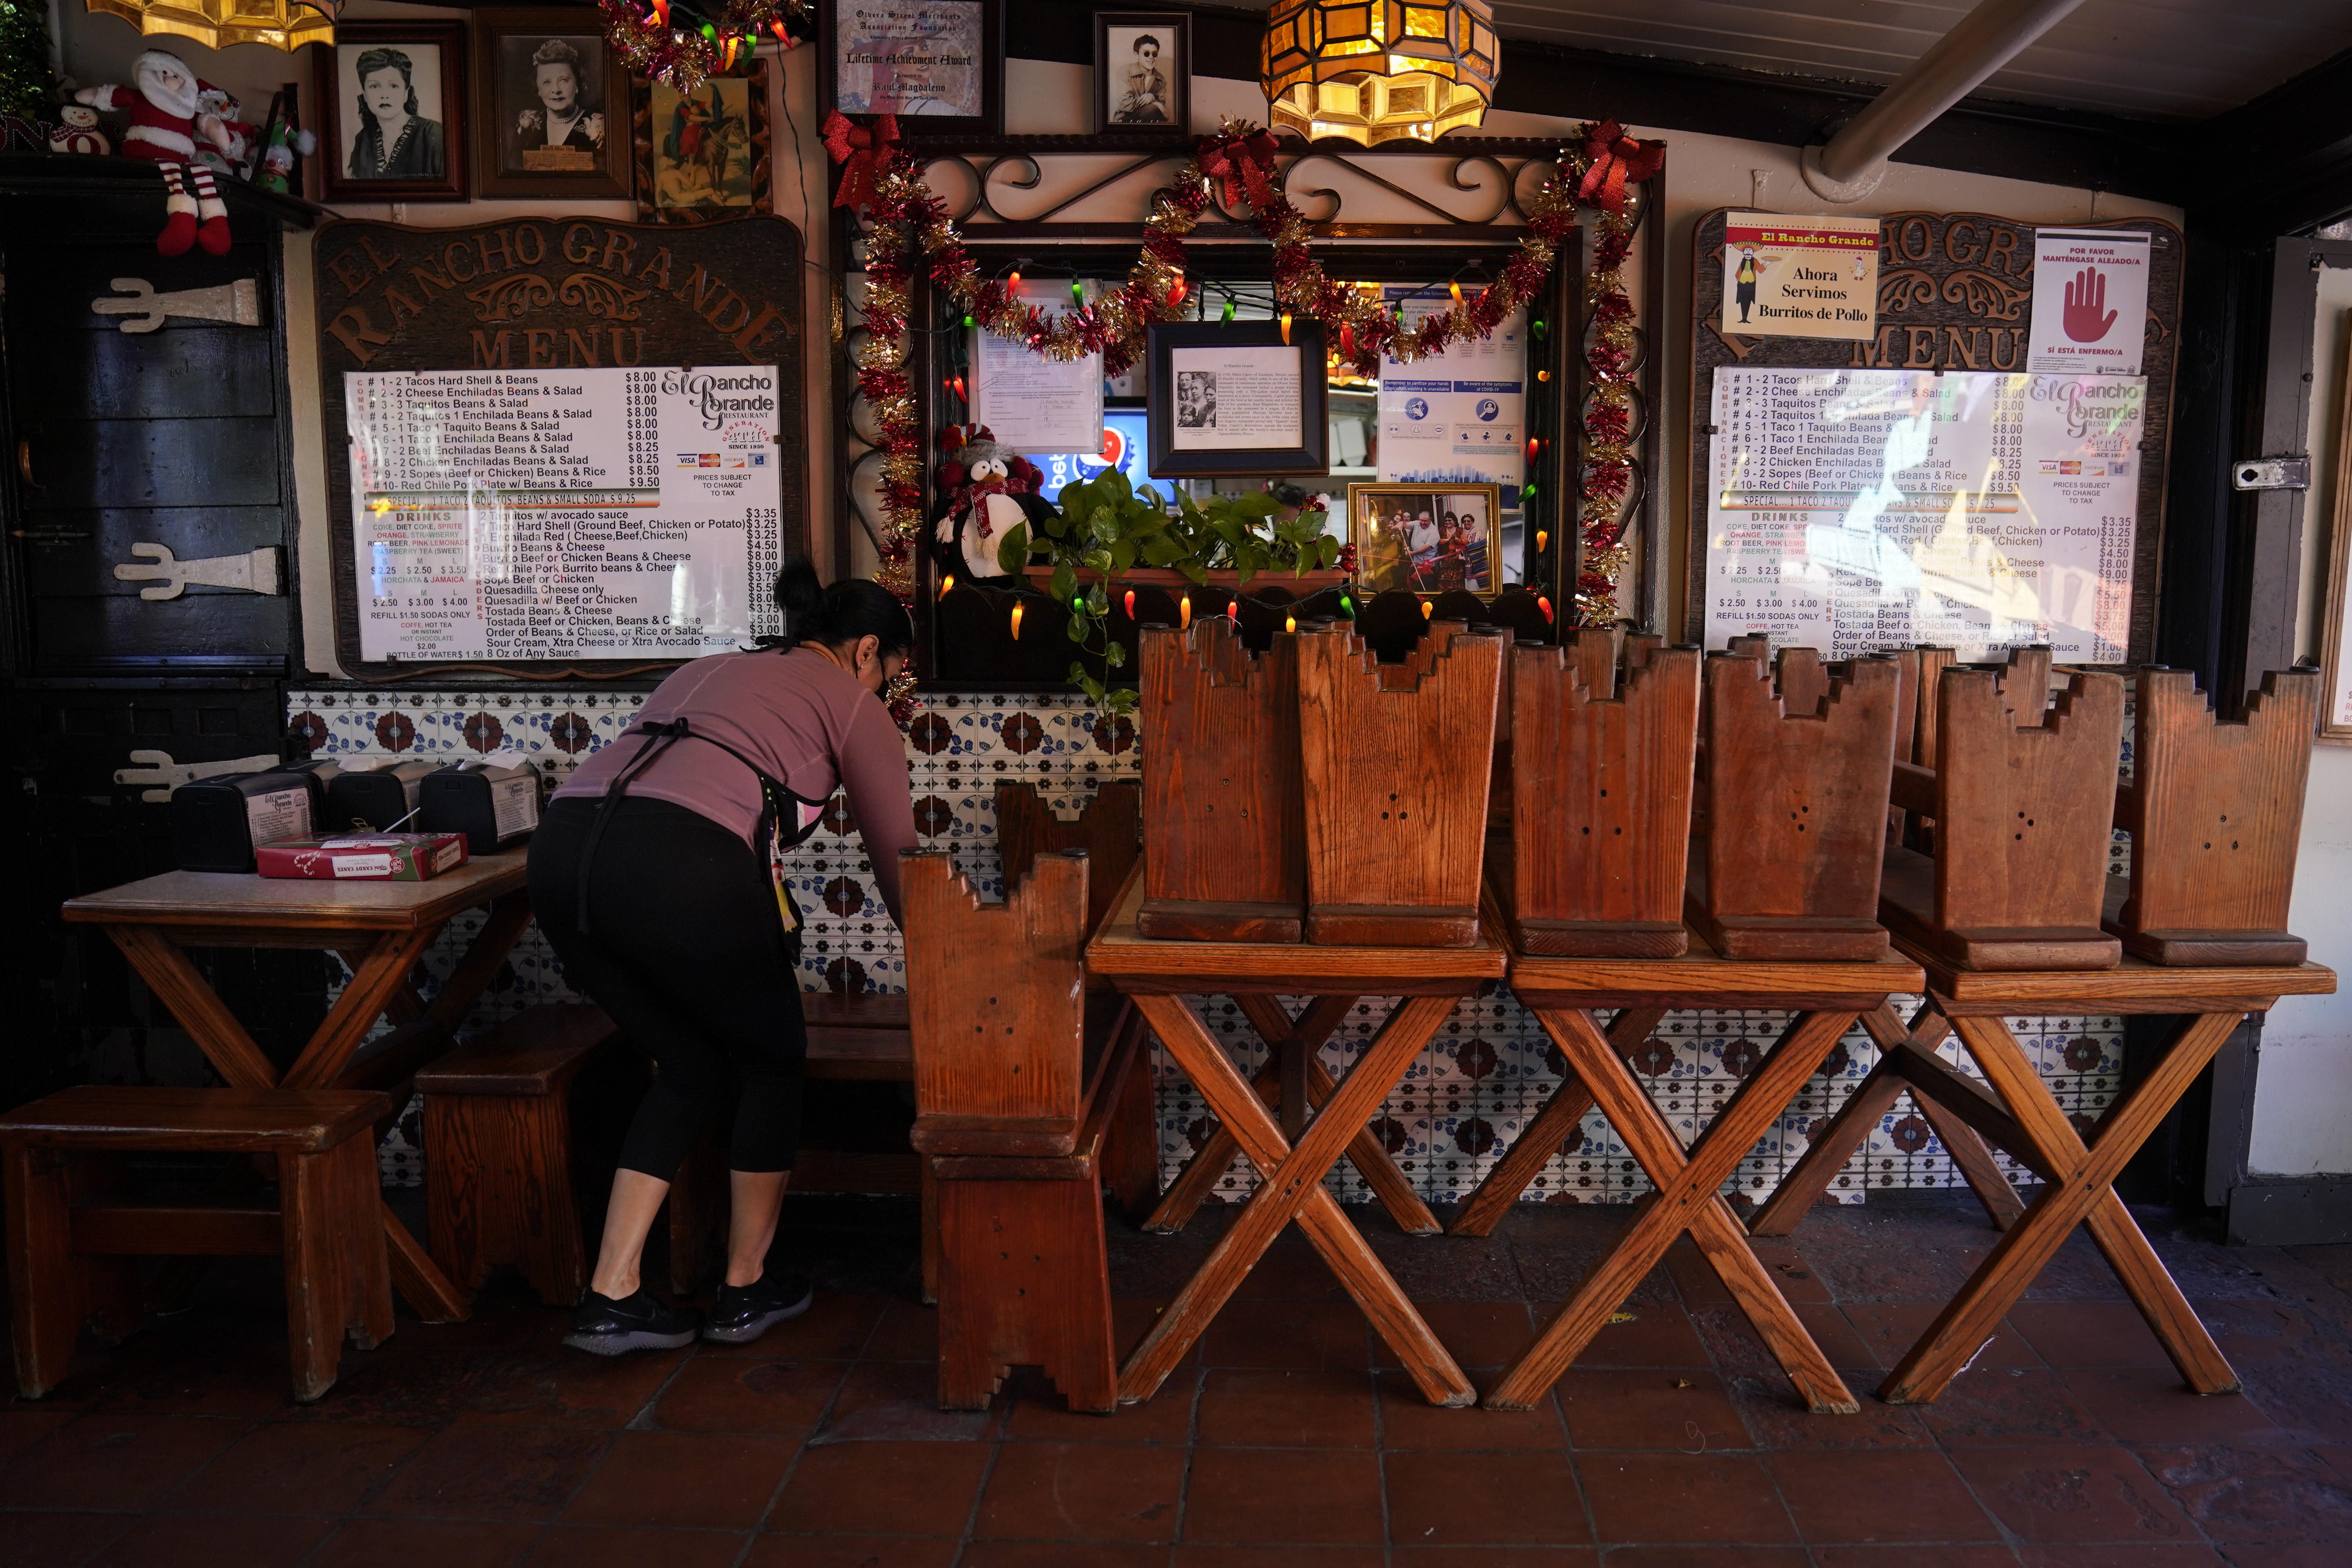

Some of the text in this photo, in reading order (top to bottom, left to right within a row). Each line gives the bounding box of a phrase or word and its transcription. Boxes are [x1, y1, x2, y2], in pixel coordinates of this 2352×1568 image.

[918, 11, 961, 20] Merchants
[860, 22, 957, 31] Association Foundation
[846, 53, 972, 66] Lifetime Achievment Award
[872, 82, 946, 94] Raul Magdaleno
[1762, 232, 1873, 245] El Rancho Grande
[326, 234, 402, 298] EL
[1793, 267, 1837, 281] Ahora
[324, 222, 798, 368] RANCHO GRANDE
[1782, 284, 1846, 299] Servimos
[1759, 305, 1867, 321] Burritos de Pollo
[469, 326, 646, 370] MENU
[1849, 325, 2022, 371] MENU
[368, 377, 374, 386] #
[381, 377, 384, 386] 1
[405, 377, 434, 385] Tacos
[439, 376, 462, 385] Hard
[466, 375, 491, 384] Shell
[495, 375, 502, 384] &
[506, 375, 537, 384] Beans
[661, 370, 772, 407] El Rancho
[2030, 376, 2139, 415] El Rancho
[701, 395, 775, 431] Grande
[2067, 404, 2139, 439] Grande
[722, 420, 770, 442] GENERATION
[397, 513, 450, 521] DRINKS
[1751, 513, 1807, 521] DRINKS
[2006, 526, 2046, 535] Chicken
[2064, 527, 2100, 538] Potato)
[484, 575, 509, 586] Sope
[513, 575, 535, 583] Beef
[553, 574, 593, 583] Chicken
[484, 585, 604, 597] Quesadilla Cheese only
[485, 606, 612, 615] Tostada Beans & Cheese
